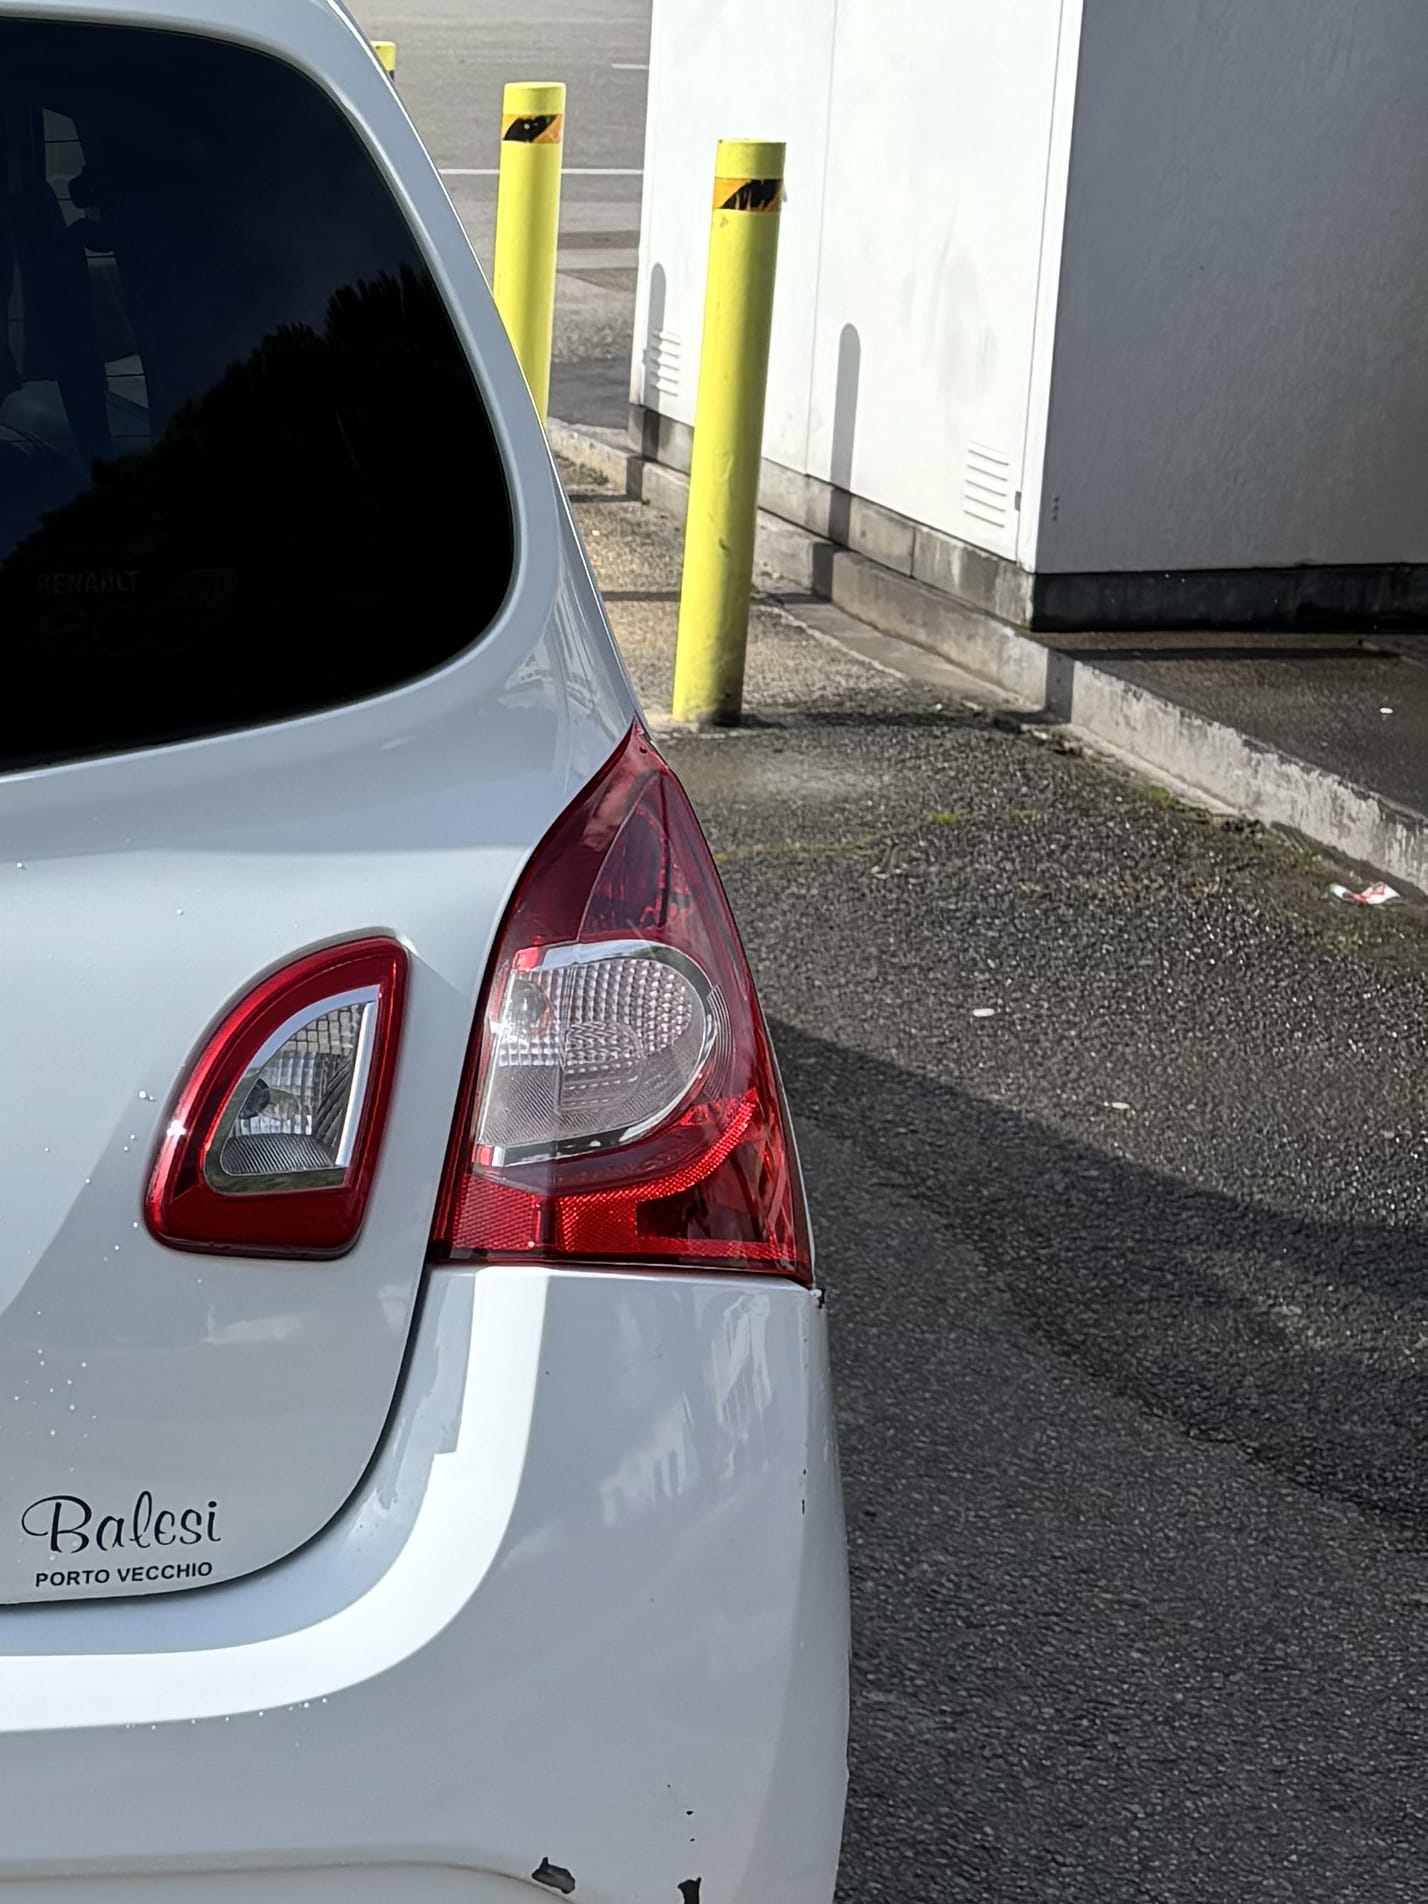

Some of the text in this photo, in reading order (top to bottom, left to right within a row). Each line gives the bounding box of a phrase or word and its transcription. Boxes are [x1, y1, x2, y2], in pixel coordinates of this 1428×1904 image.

[37, 568, 143, 595] RENAULT
[21, 1490, 222, 1554] Balesi
[35, 1561, 213, 1588] PORTO VECCHIO
